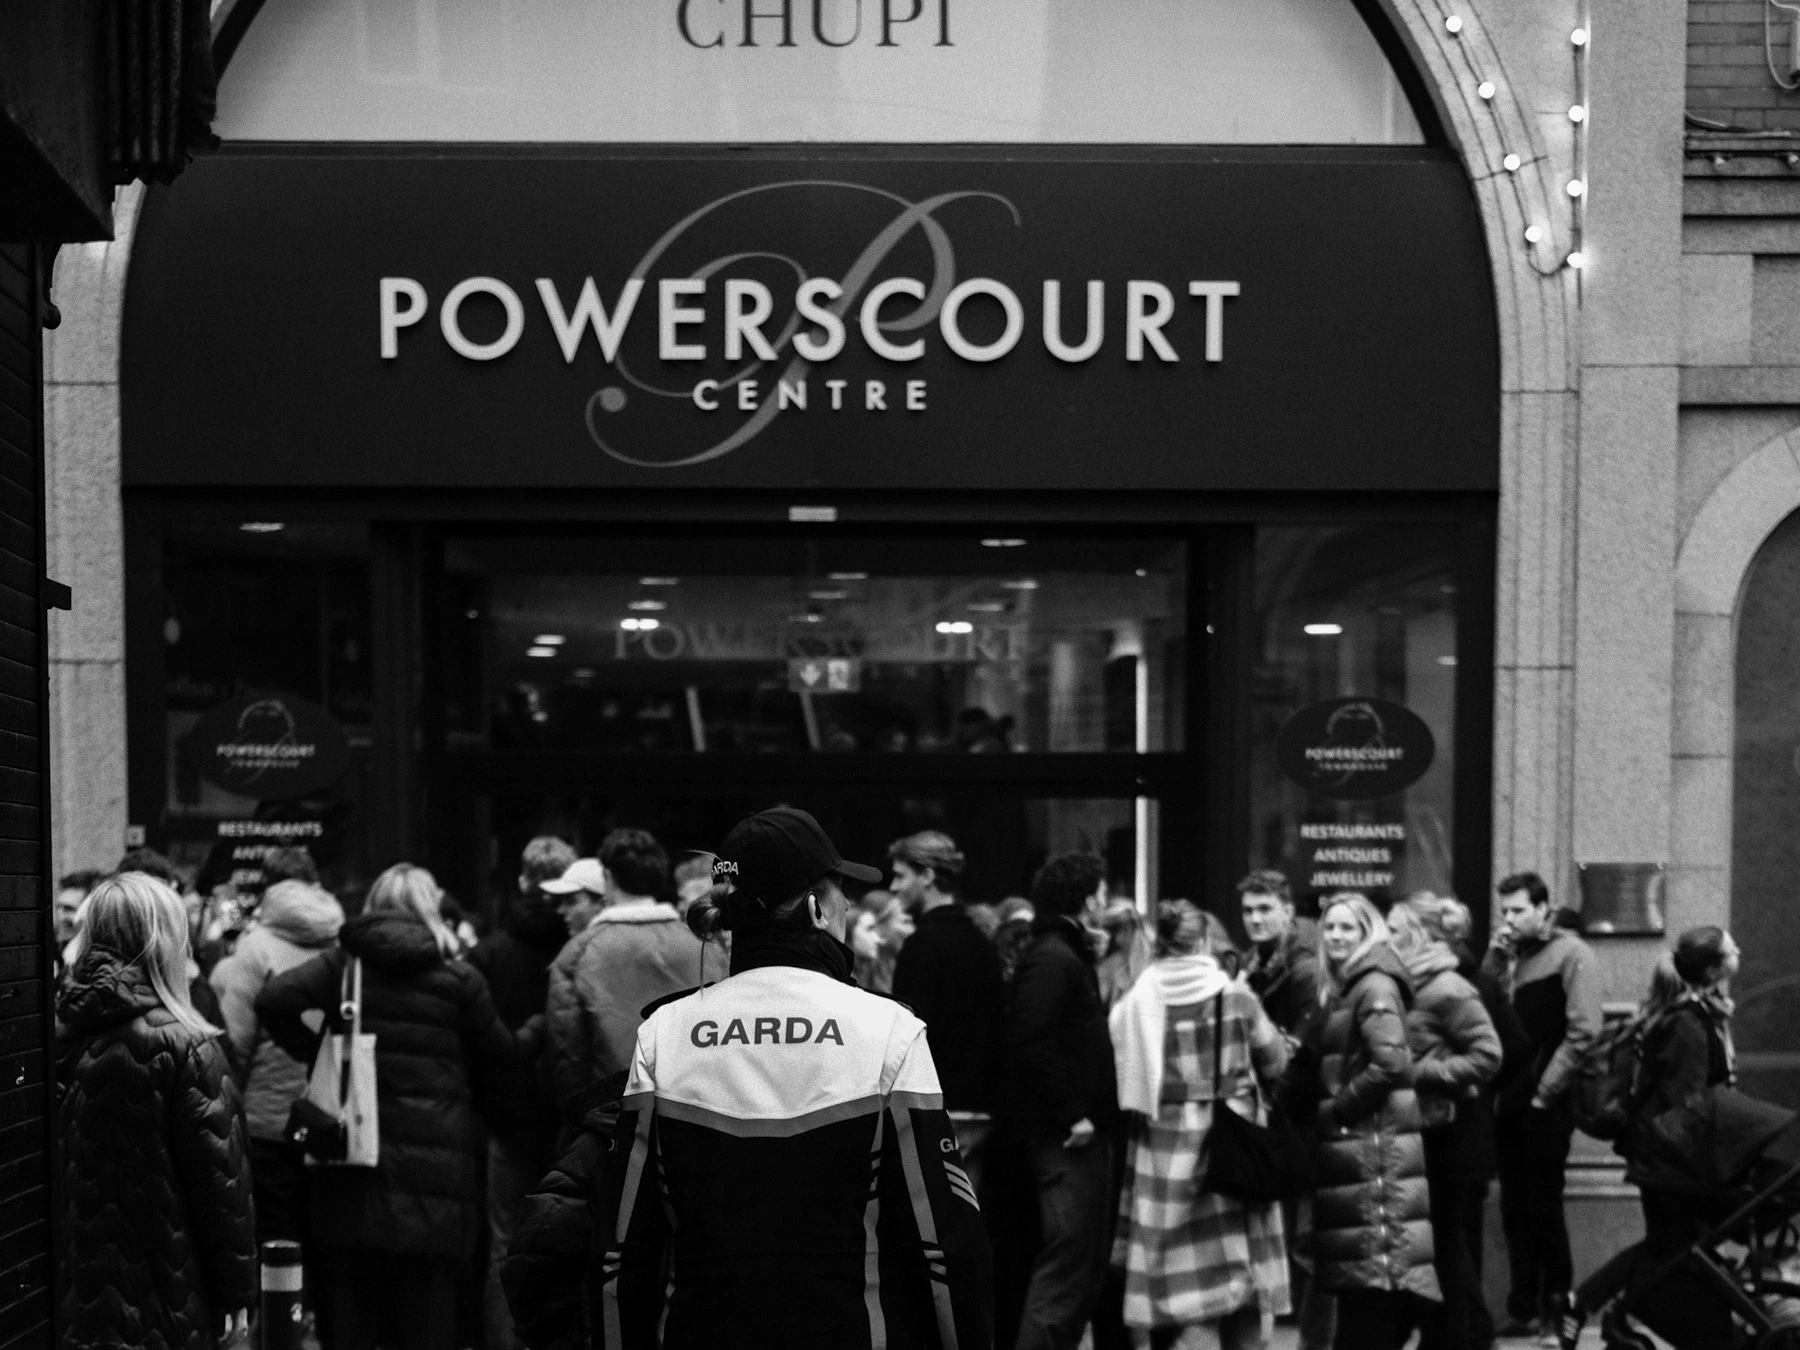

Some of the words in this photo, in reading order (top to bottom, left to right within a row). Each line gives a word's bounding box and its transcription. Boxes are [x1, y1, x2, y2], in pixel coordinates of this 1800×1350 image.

[676, 0, 954, 48] CHUPI
[379, 276, 1241, 363] POWERSCOURT
[692, 380, 928, 411] CENTRE
[1304, 746, 1404, 761] POWERSCOURT
[217, 821, 323, 838] RESTAURANTS
[1300, 823, 1405, 840] RESTAURANTS
[1313, 847, 1391, 864] ANTIQUES
[1310, 870, 1395, 887] JEWELLERY
[690, 1017, 844, 1049] GARDA
